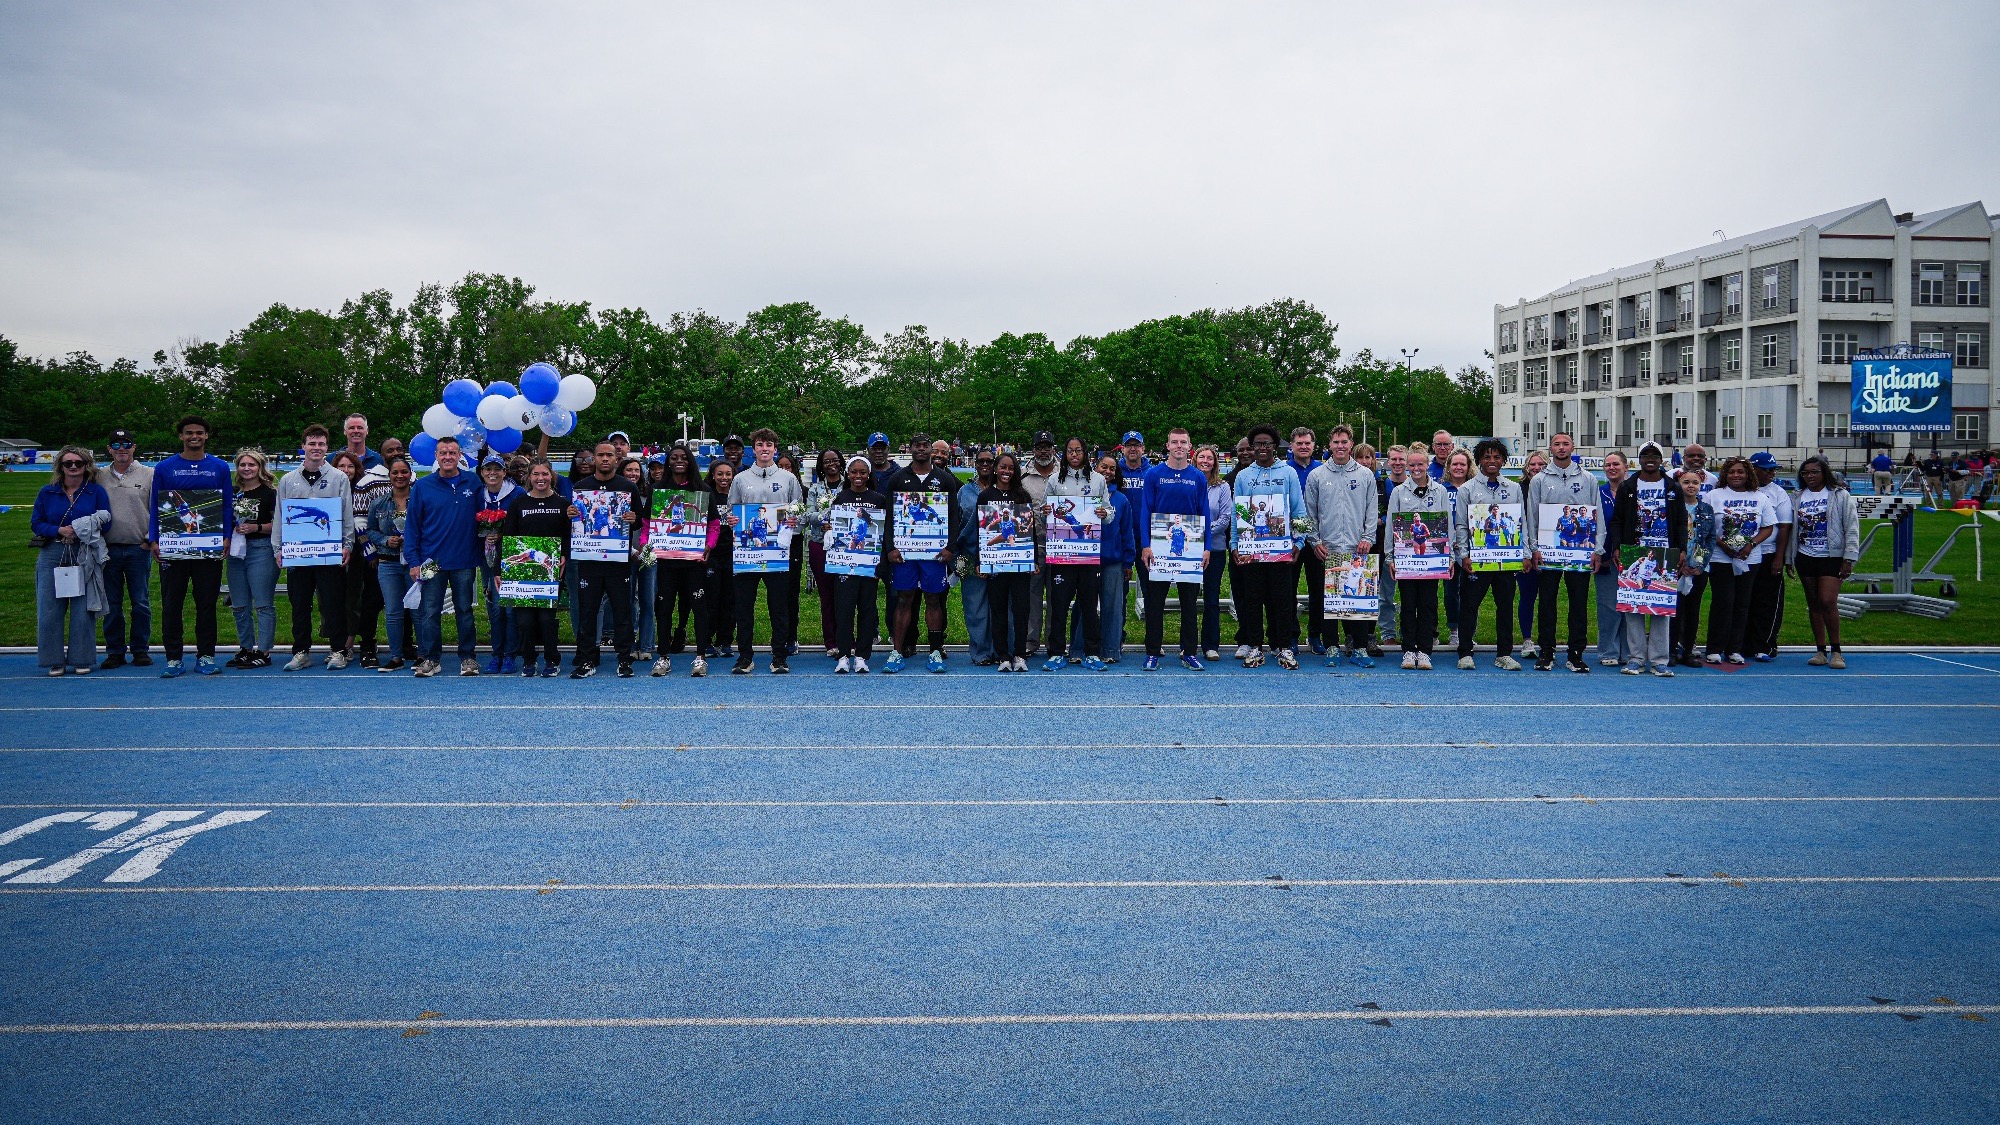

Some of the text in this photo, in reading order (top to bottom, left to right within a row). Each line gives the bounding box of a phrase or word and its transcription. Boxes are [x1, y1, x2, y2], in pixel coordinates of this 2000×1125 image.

[1908, 352, 1953, 360] UNIVERSITY
[1863, 364, 1941, 390] Indiana
[1861, 388, 1939, 414] State
